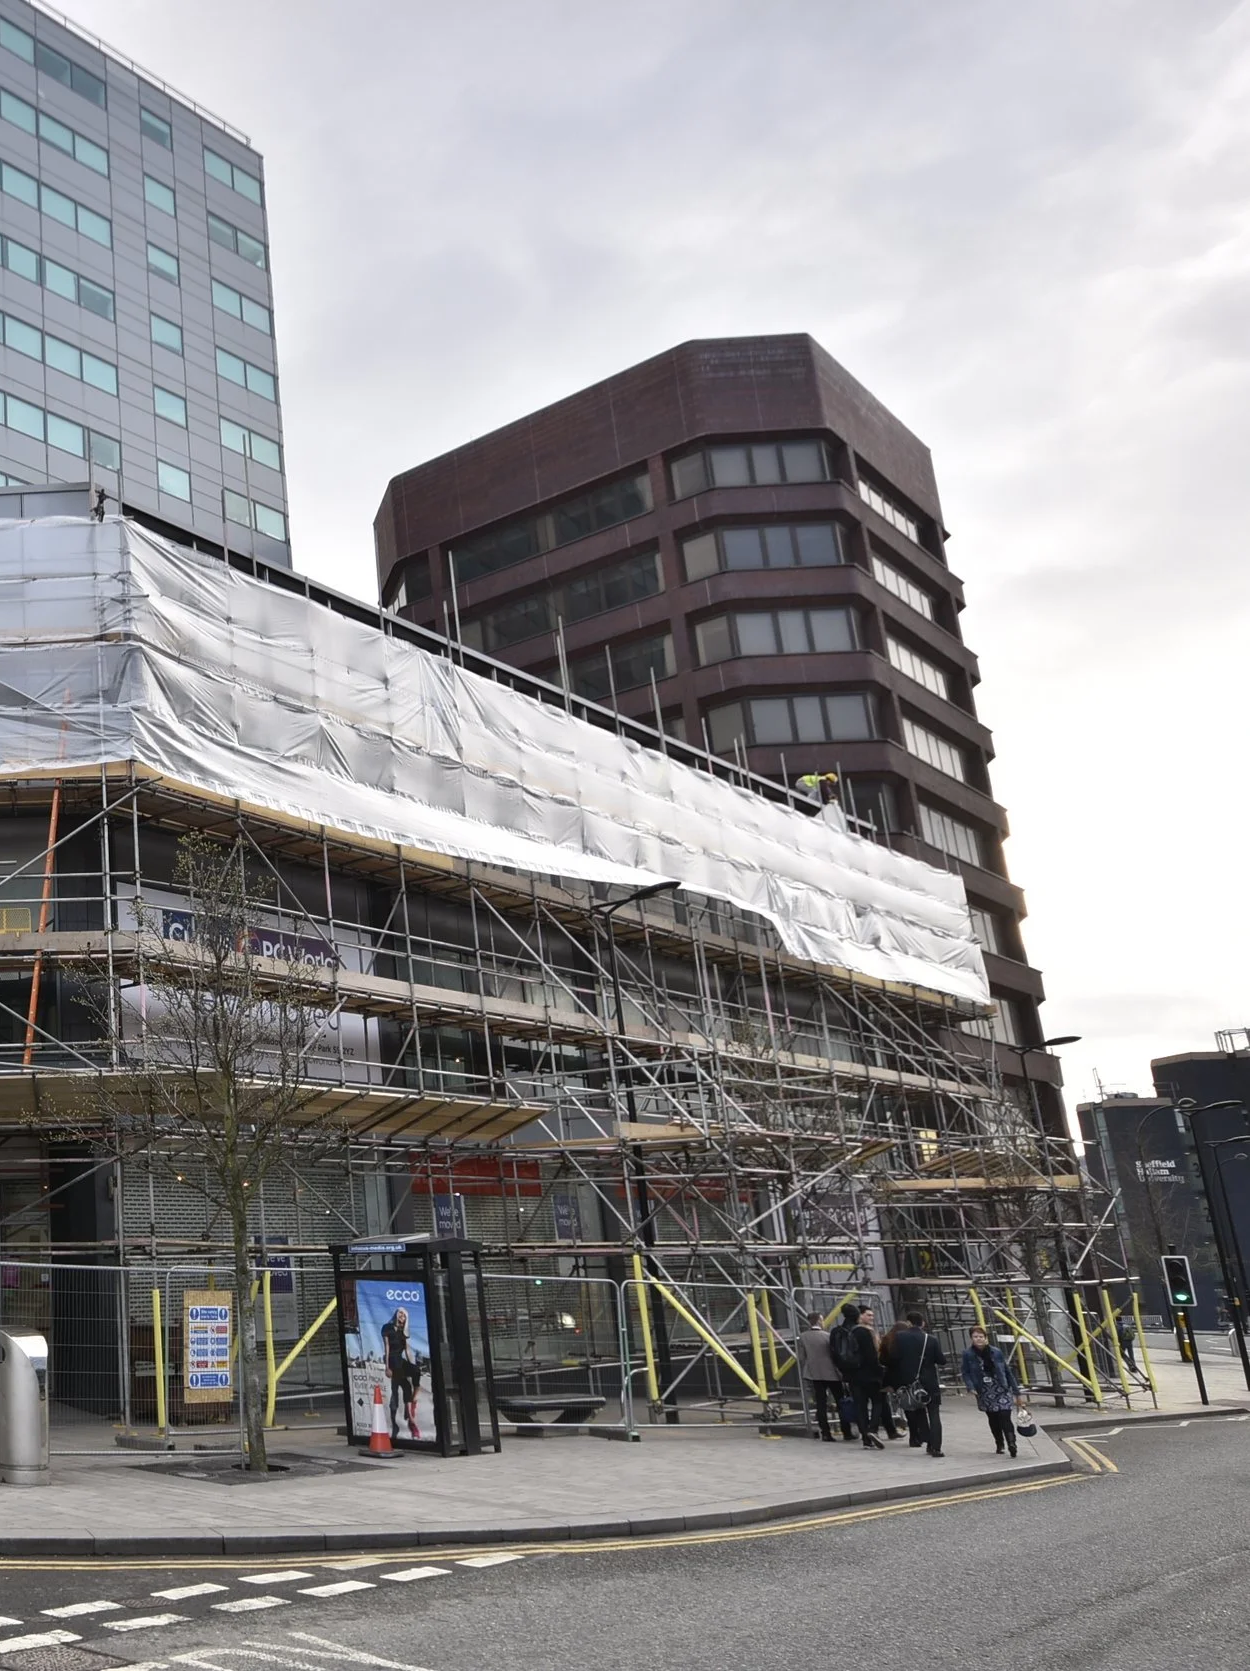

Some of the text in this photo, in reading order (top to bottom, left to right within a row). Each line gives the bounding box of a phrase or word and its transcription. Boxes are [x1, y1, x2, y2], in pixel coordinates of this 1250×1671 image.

[262, 940, 286, 960] PC
[317, 1044, 332, 1053] Park
[1135, 1160, 1176, 1168] Seffield
[438, 1206, 459, 1217] We'e
[557, 1204, 576, 1216] Wee
[439, 1219, 462, 1230] movd
[558, 1217, 578, 1227] mod
[386, 1289, 420, 1302] ecco
